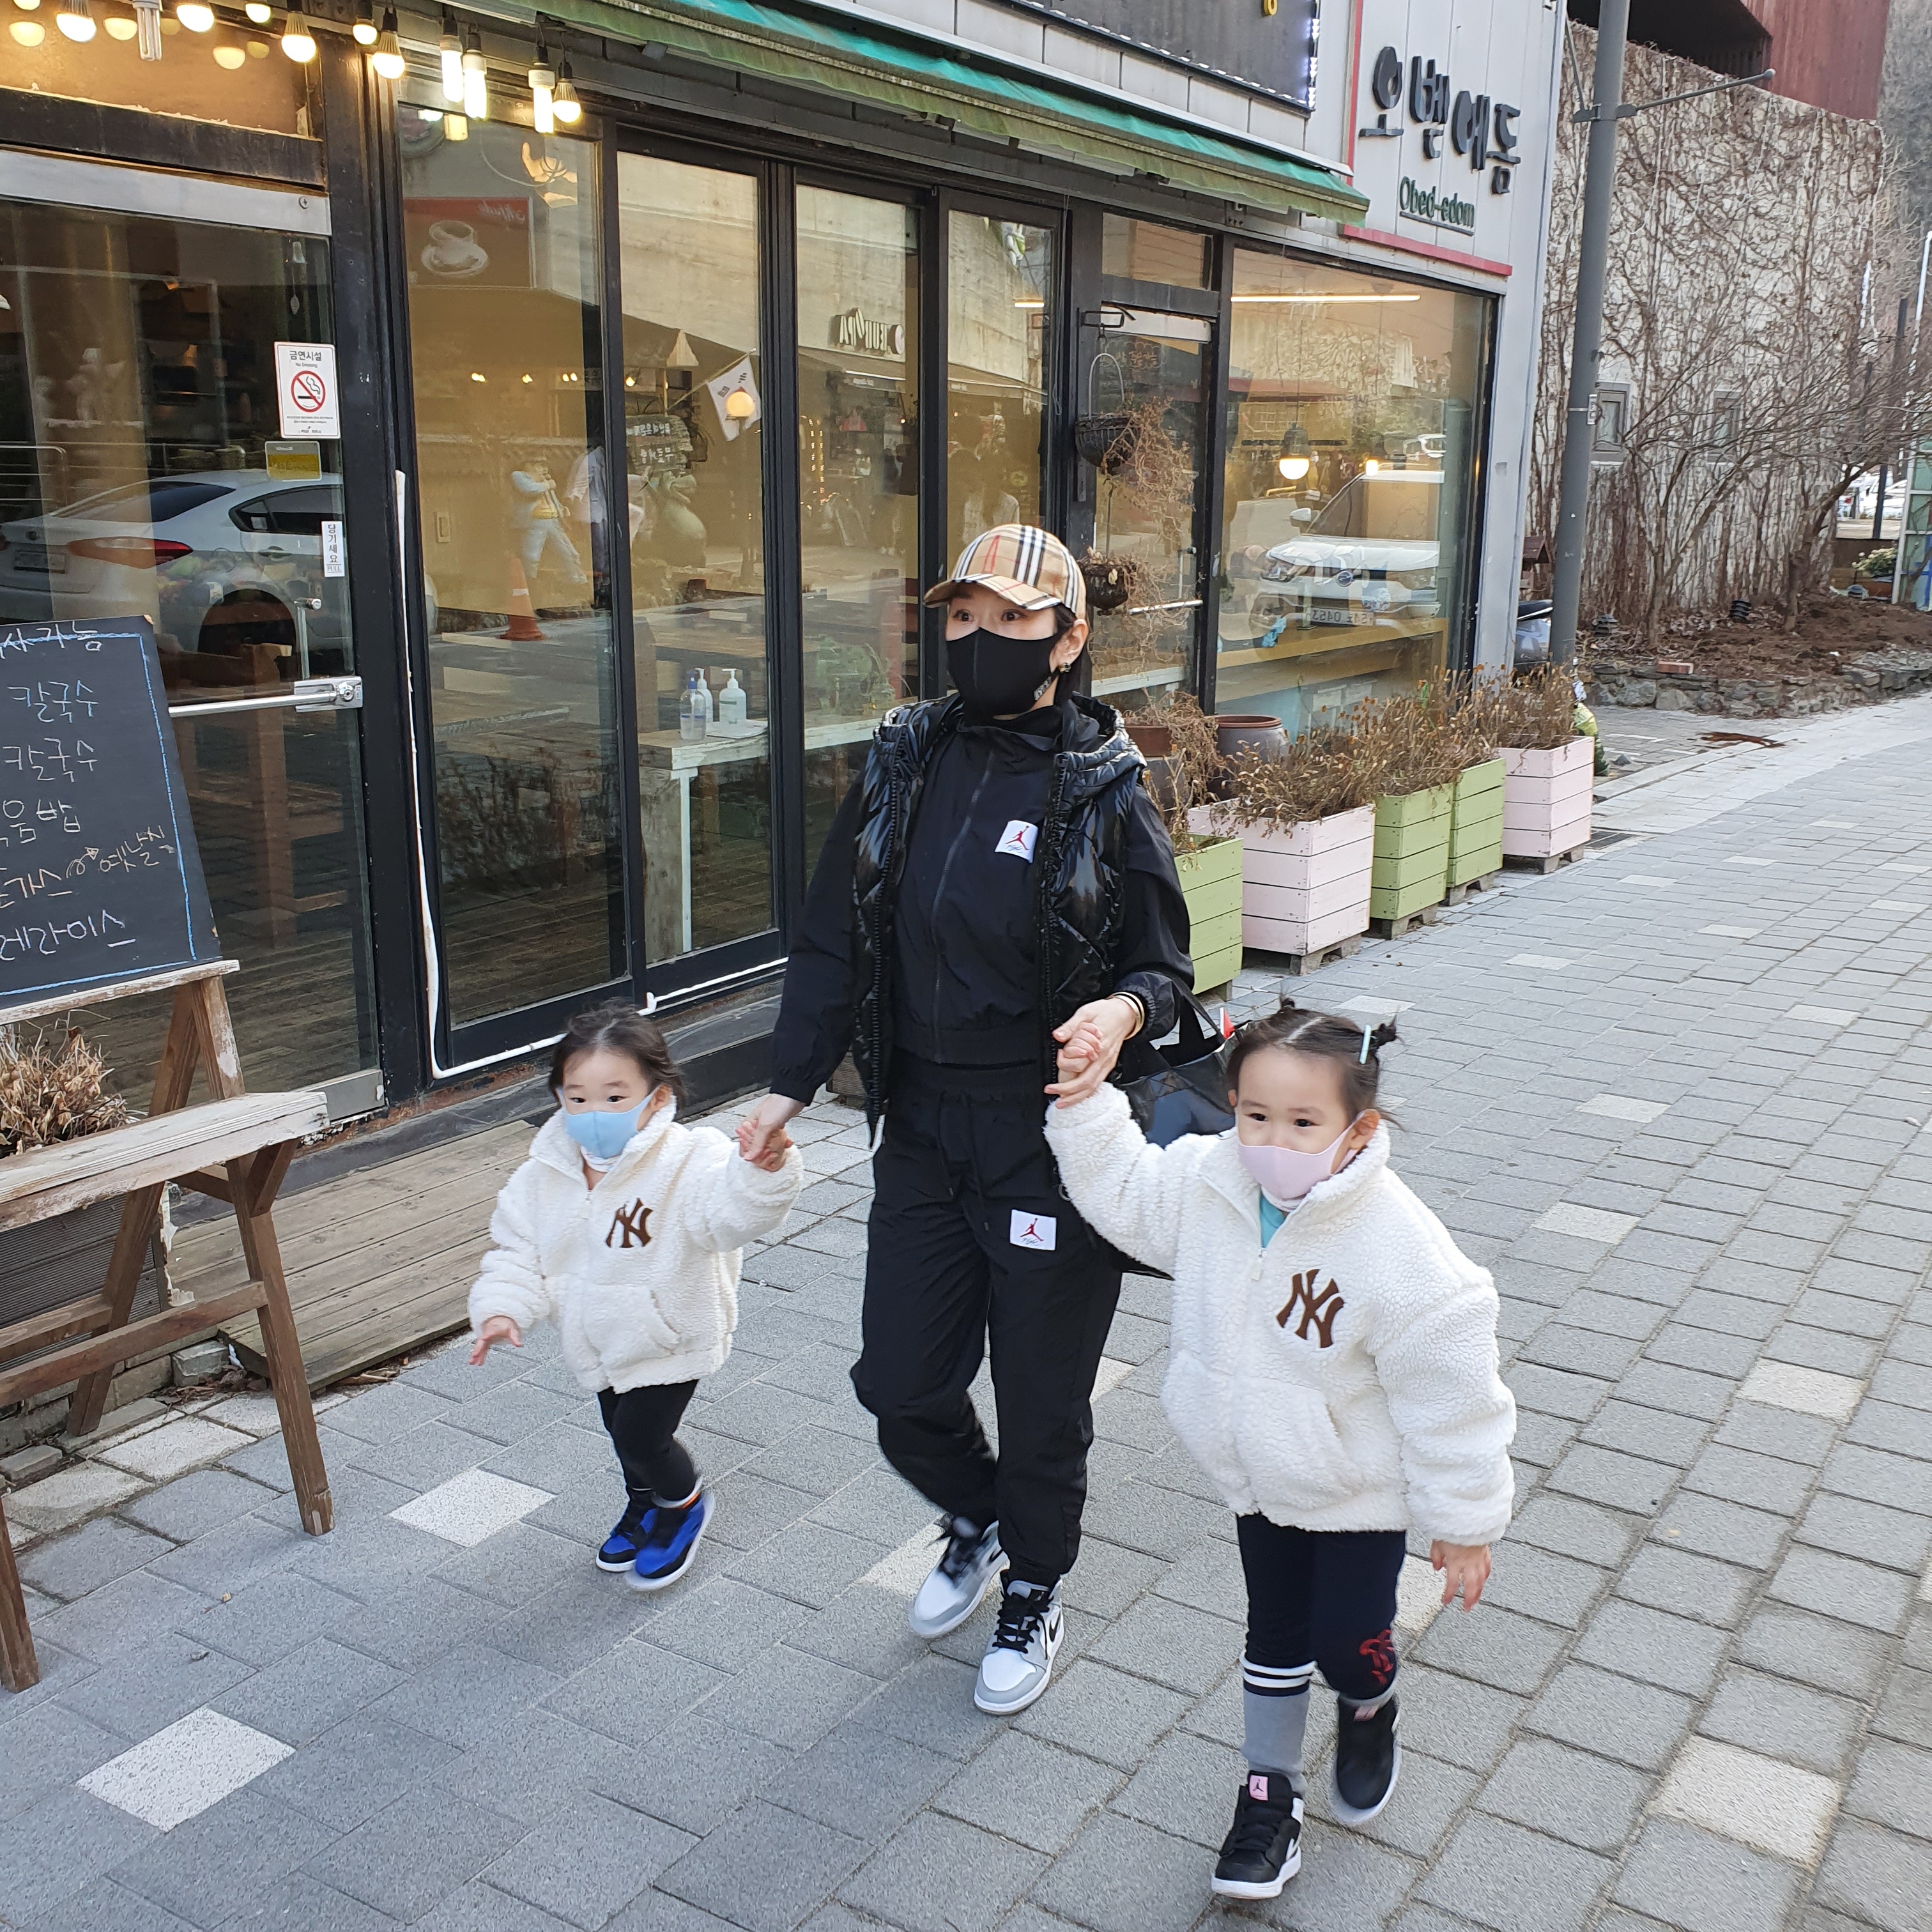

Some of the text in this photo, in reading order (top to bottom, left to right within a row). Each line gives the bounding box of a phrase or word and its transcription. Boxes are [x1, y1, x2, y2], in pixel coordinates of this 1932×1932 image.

[1359, 46, 1521, 194] 오벧에돔
[1399, 176, 1475, 227] Obed-edom
[289, 350, 322, 362] 금연시설
[328, 524, 339, 563] 당기세요
[7, 679, 99, 724] 칼국수
[3, 737, 98, 783] 칼국수
[0, 799, 81, 848] 음밥
[1276, 1268, 1346, 1348] NY
